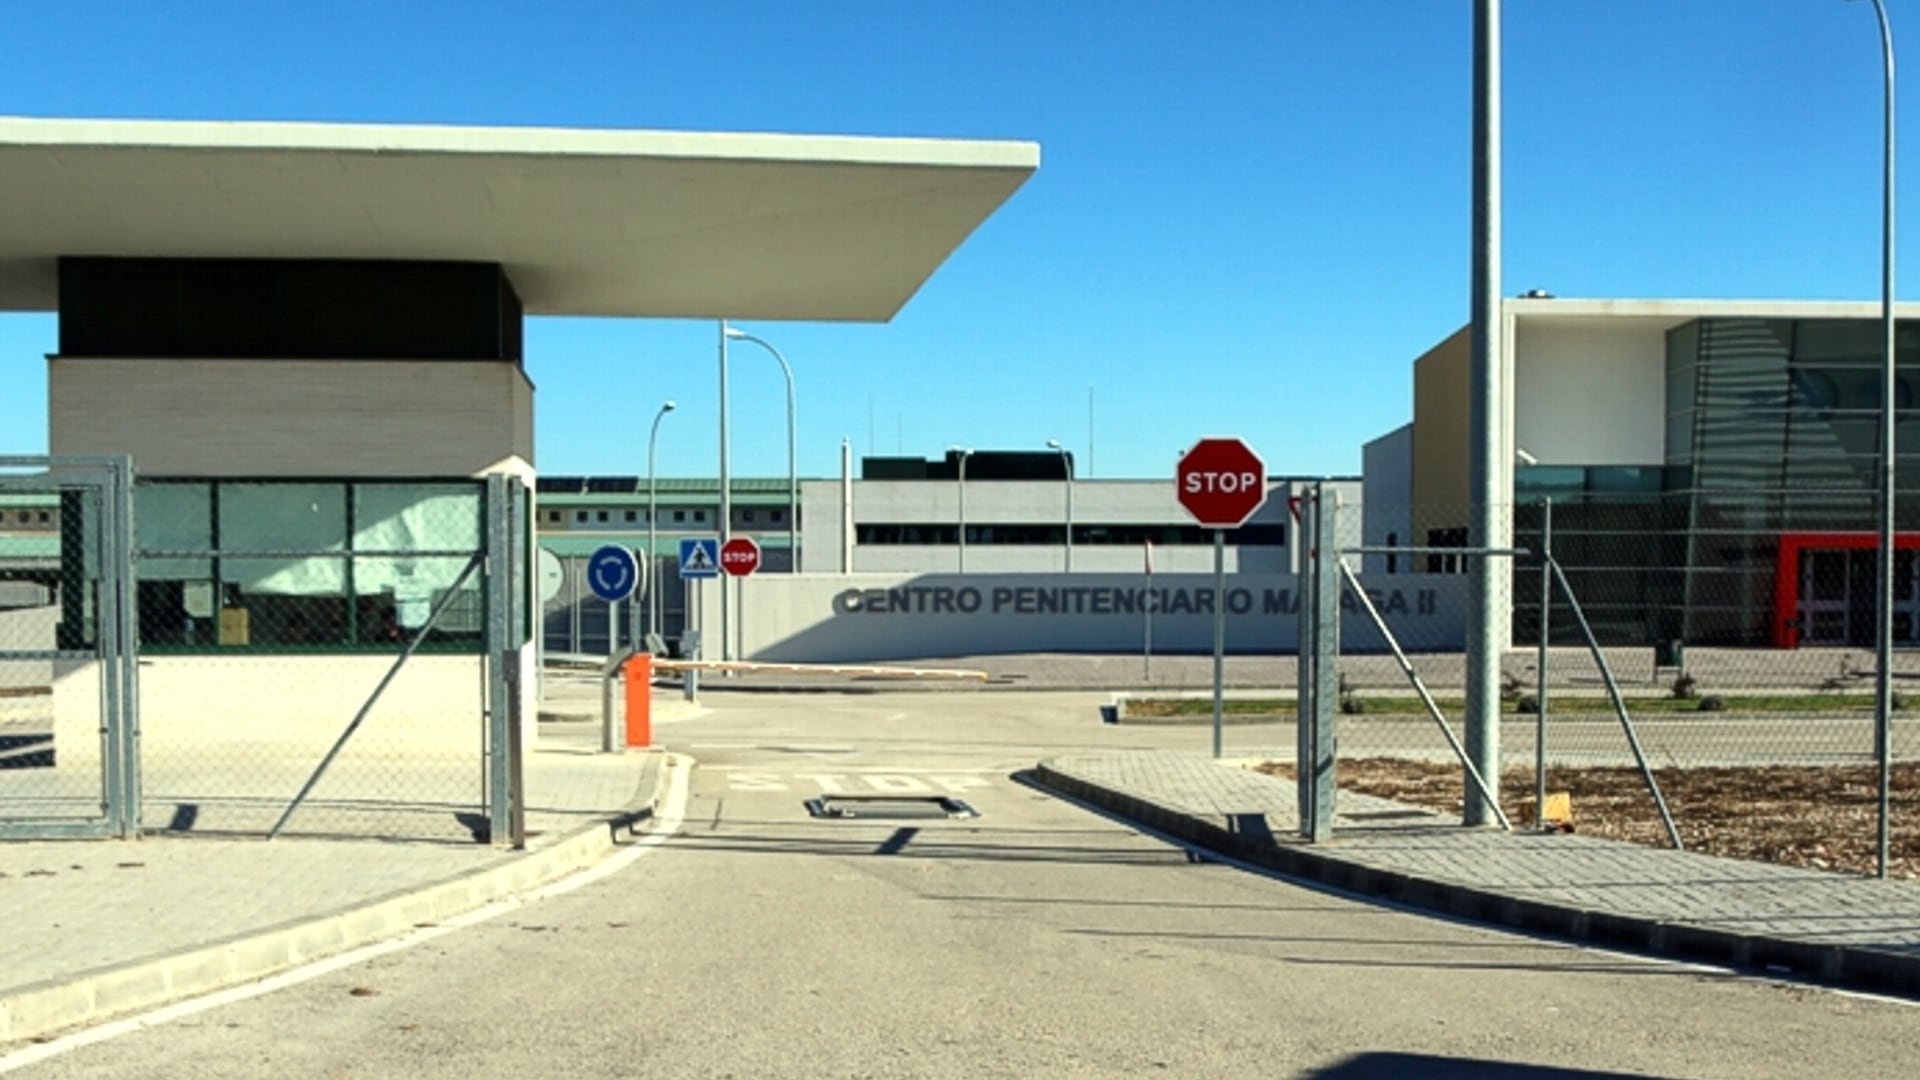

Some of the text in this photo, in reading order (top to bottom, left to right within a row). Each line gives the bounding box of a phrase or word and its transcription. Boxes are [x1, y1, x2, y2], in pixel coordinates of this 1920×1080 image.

[1185, 472, 1257, 493] STOP
[723, 552, 756, 563] STOP
[842, 587, 1436, 615] CENTRO PENITENCIARIO MAGA II
[726, 773, 993, 793] STOP
